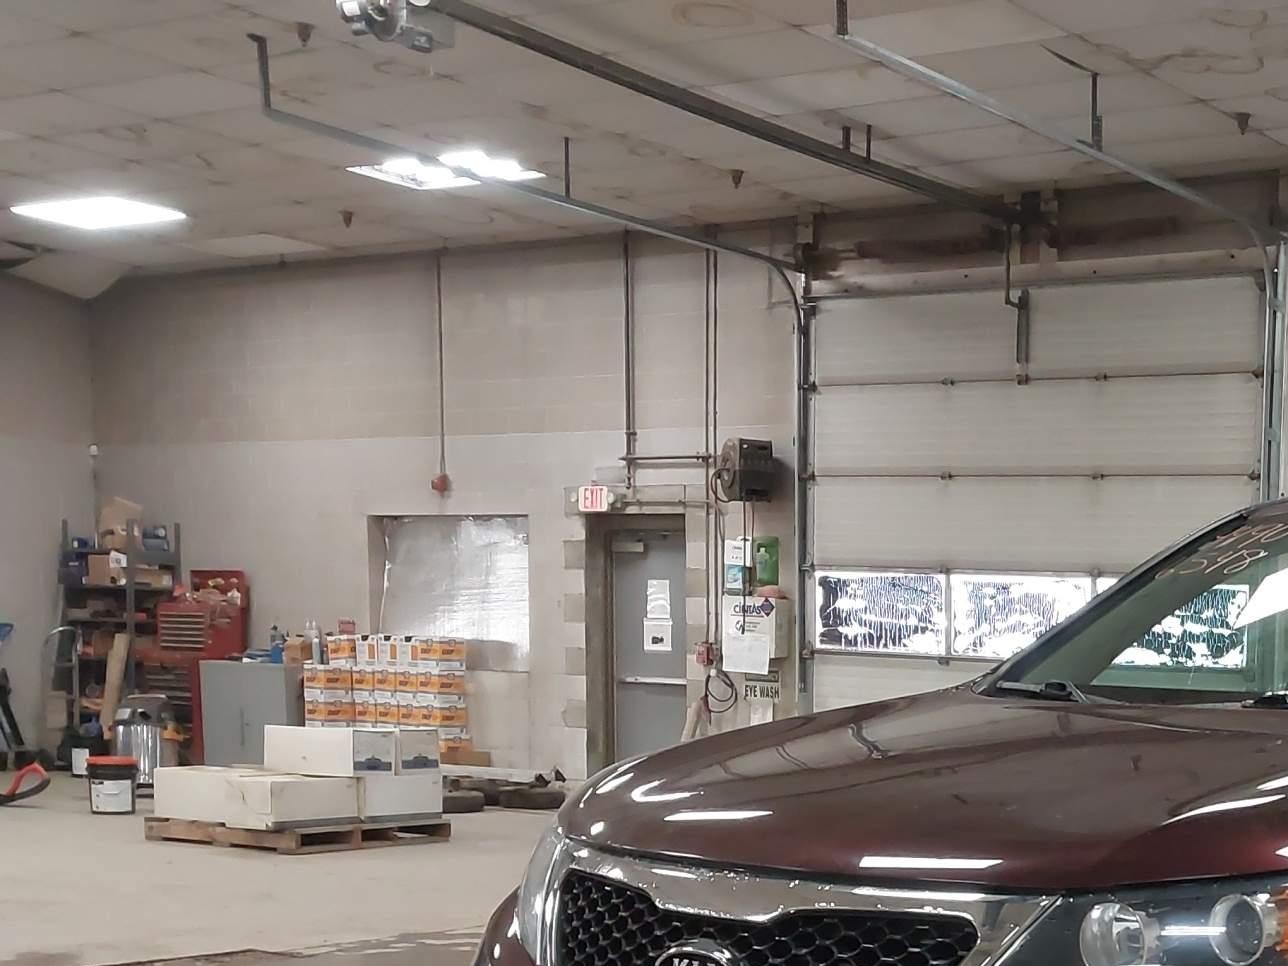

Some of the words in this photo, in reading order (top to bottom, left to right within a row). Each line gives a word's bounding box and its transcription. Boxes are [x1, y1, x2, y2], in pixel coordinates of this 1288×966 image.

[584, 488, 603, 508] EXIT
[744, 684, 758, 698] EYE
[759, 685, 780, 699] WASH
